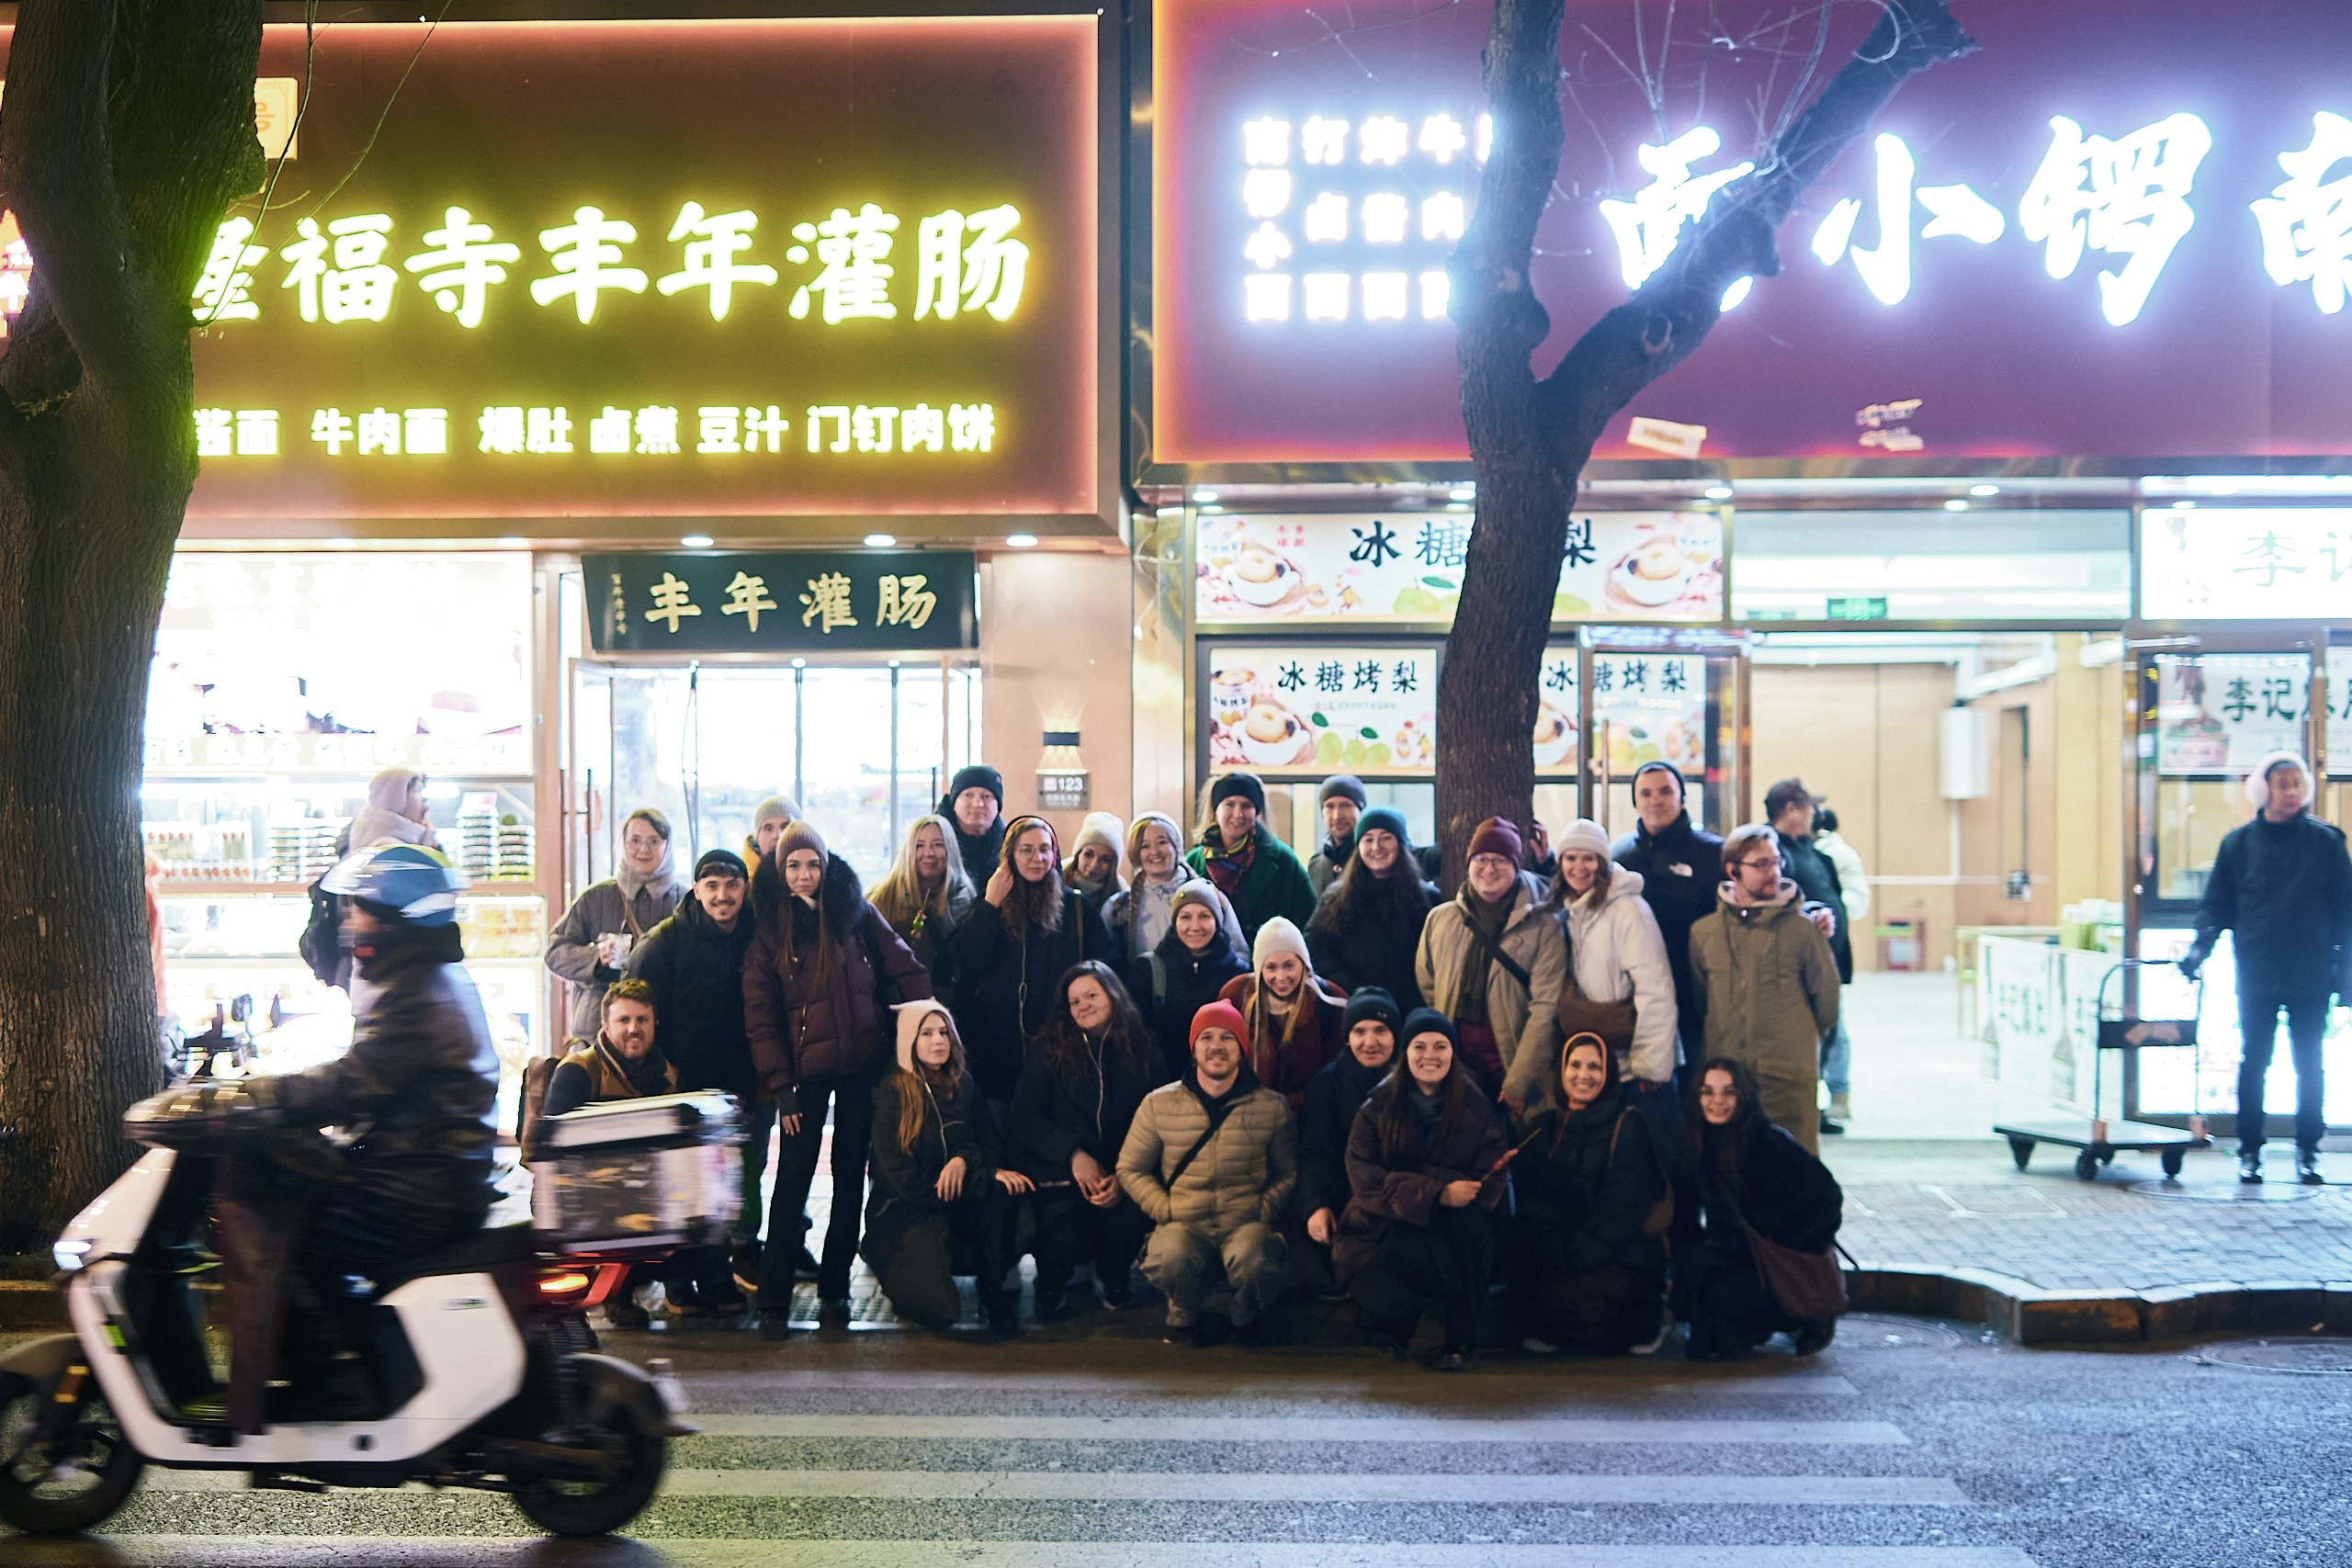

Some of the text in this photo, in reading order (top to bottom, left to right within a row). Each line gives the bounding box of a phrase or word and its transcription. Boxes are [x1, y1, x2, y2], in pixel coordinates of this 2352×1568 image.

[311, 407, 447, 455] 牛肉面
[479, 406, 573, 454] 爆肚
[590, 405, 681, 454] 卤煮
[697, 405, 789, 453] 豆汁
[807, 403, 995, 453] 门钉肉饼
[645, 570, 938, 634] 丰年灌肠
[1278, 660, 1418, 694] 冰糖烤梨
[1057, 777, 1083, 791] 123
